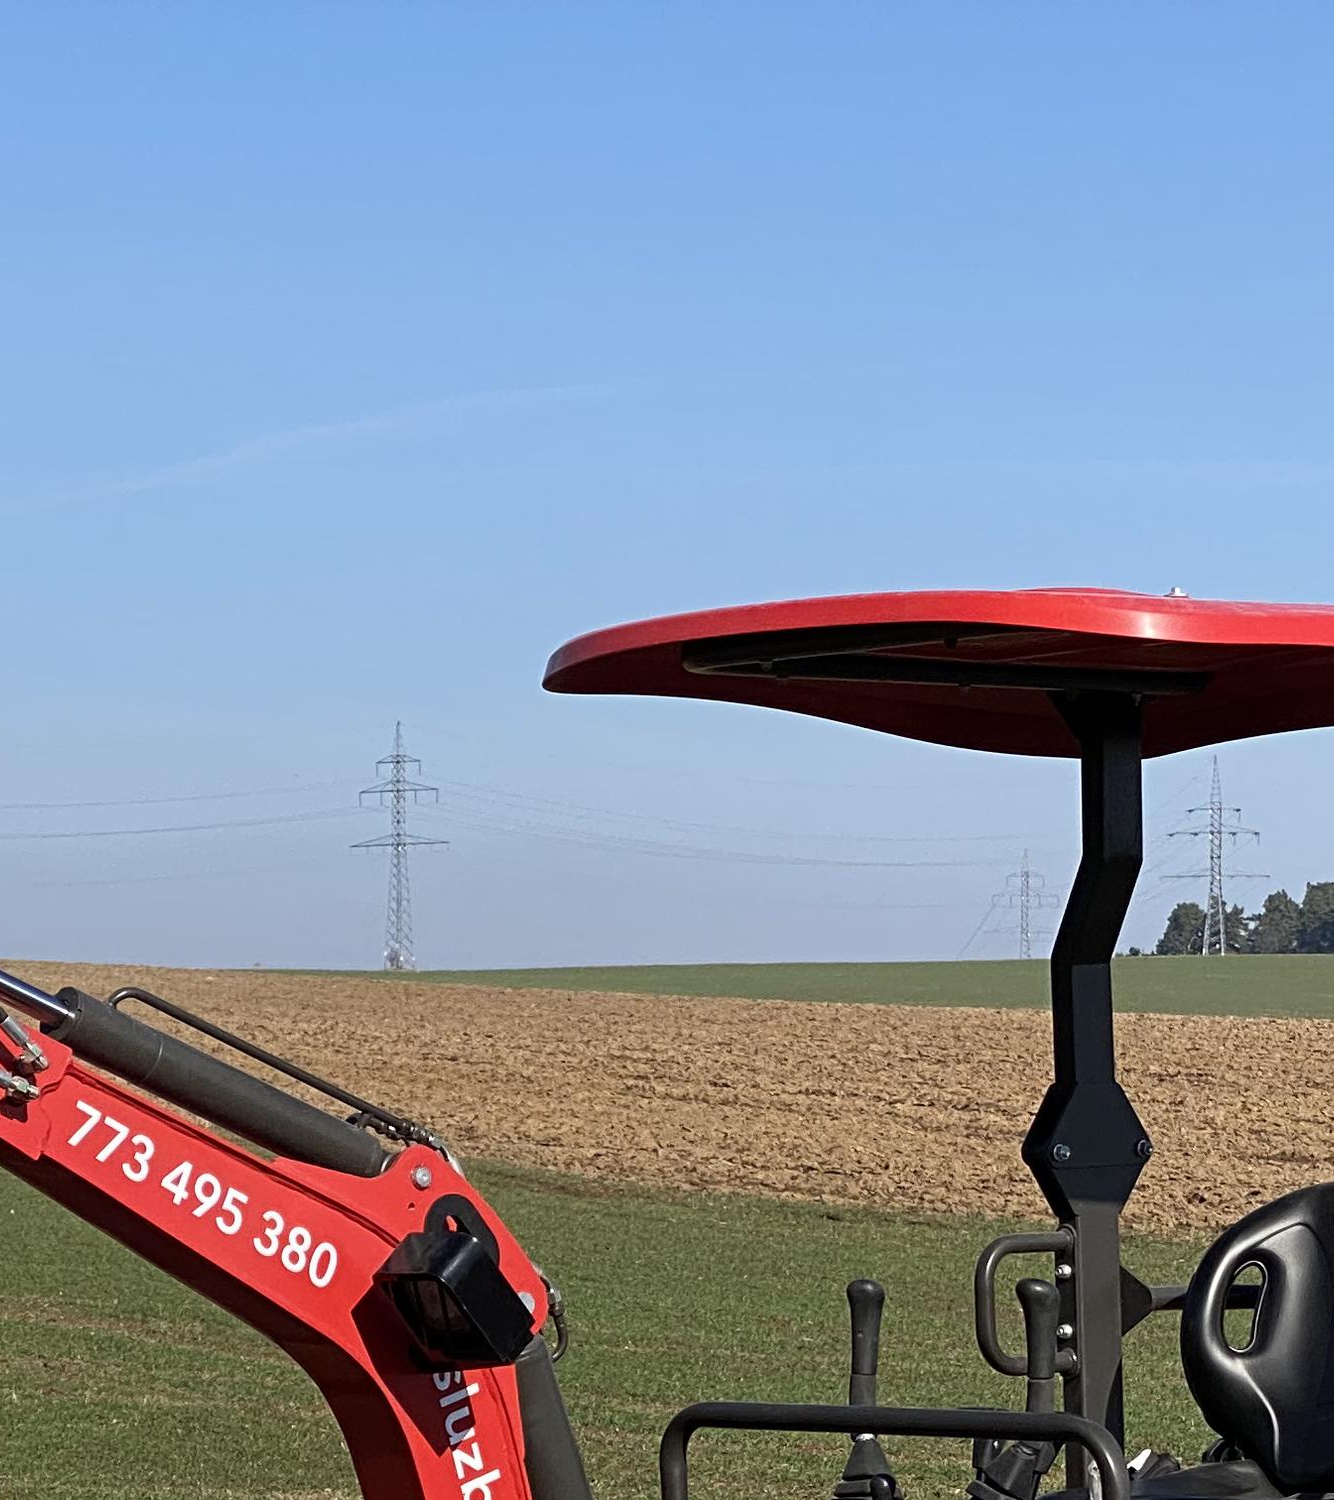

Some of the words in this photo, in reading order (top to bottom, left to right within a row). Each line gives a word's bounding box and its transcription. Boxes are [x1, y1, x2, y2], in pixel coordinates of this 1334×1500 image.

[67, 1100, 155, 1183] 773
[161, 1161, 249, 1235] 495
[253, 1210, 338, 1288] 380
